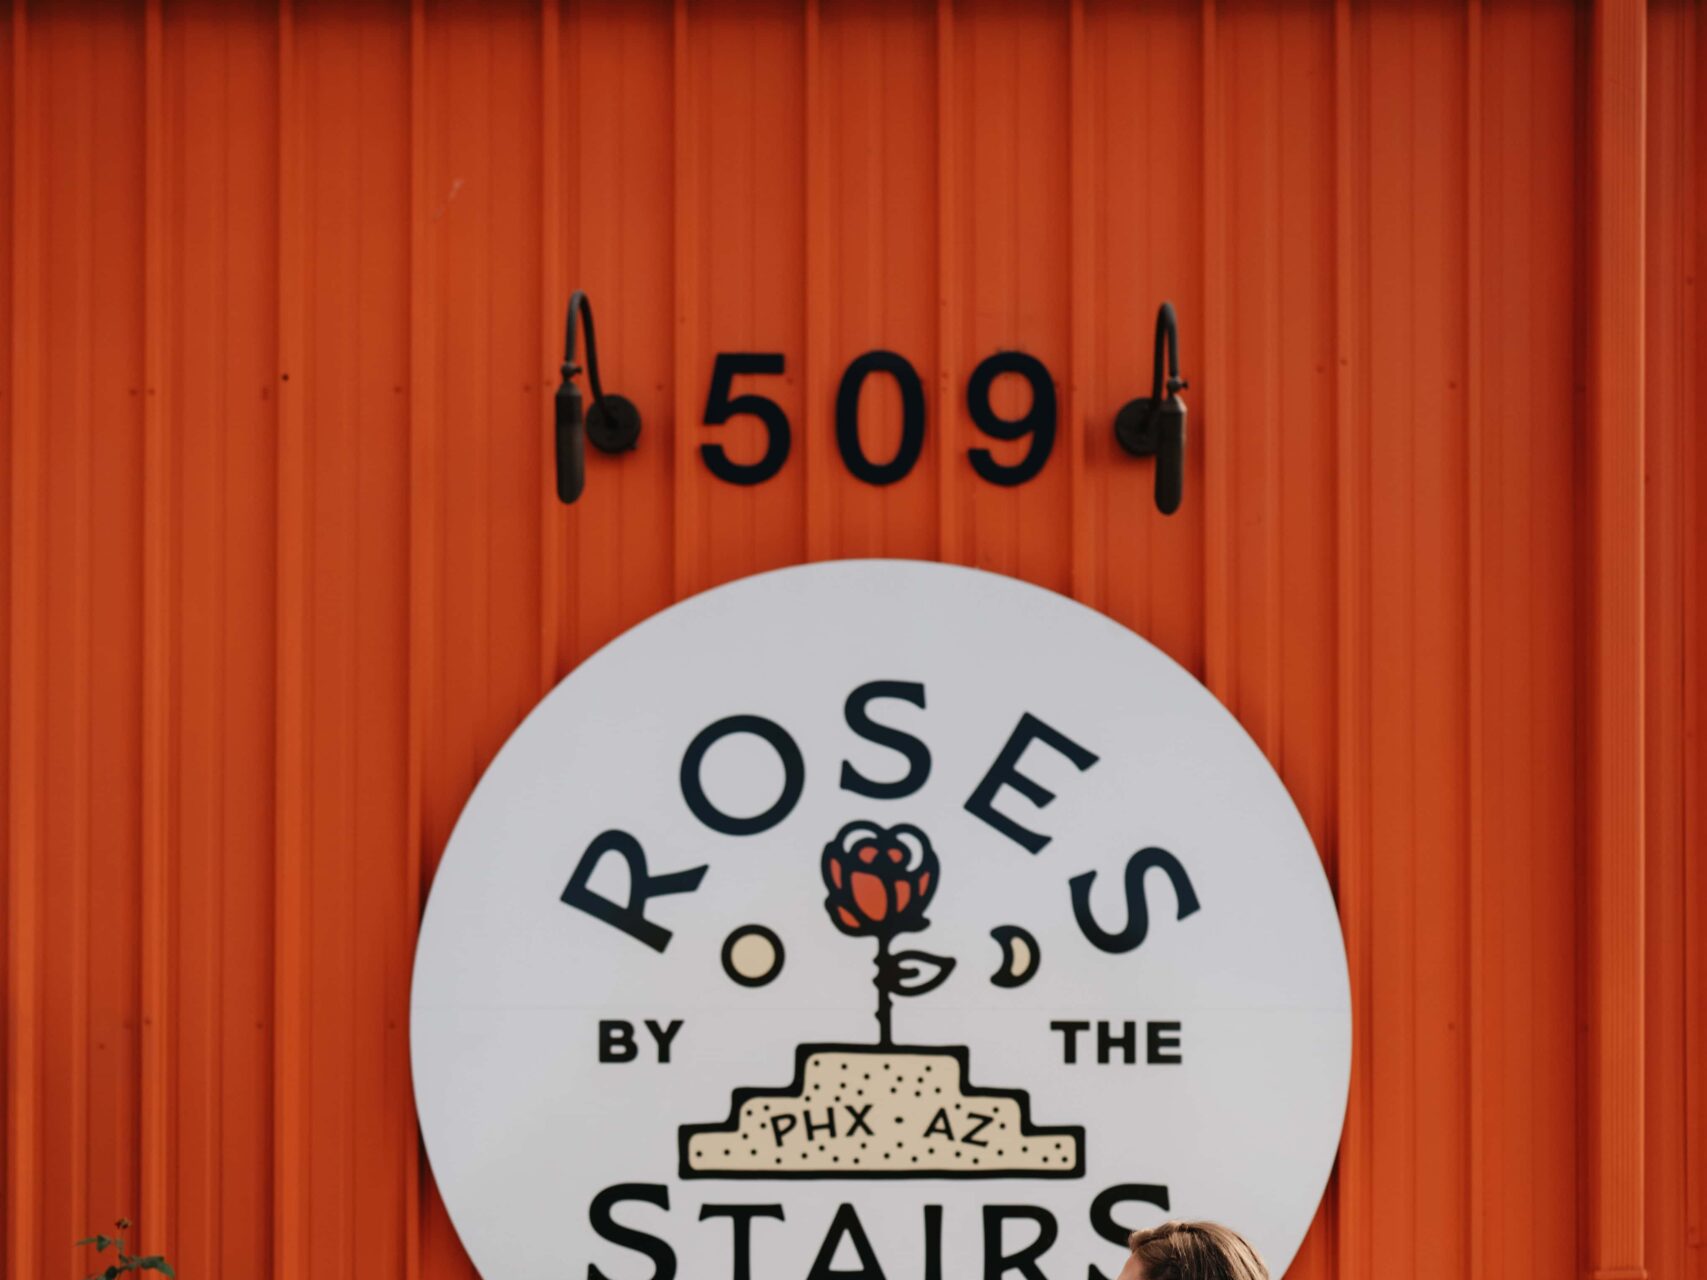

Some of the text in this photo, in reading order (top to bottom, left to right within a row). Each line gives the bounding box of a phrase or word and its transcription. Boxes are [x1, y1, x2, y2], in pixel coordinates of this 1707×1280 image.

[699, 350, 1059, 487] 509
[560, 680, 1201, 955] ROSES
[598, 1020, 1182, 1065] BY THE
[770, 1104, 995, 1148] PHX AZ
